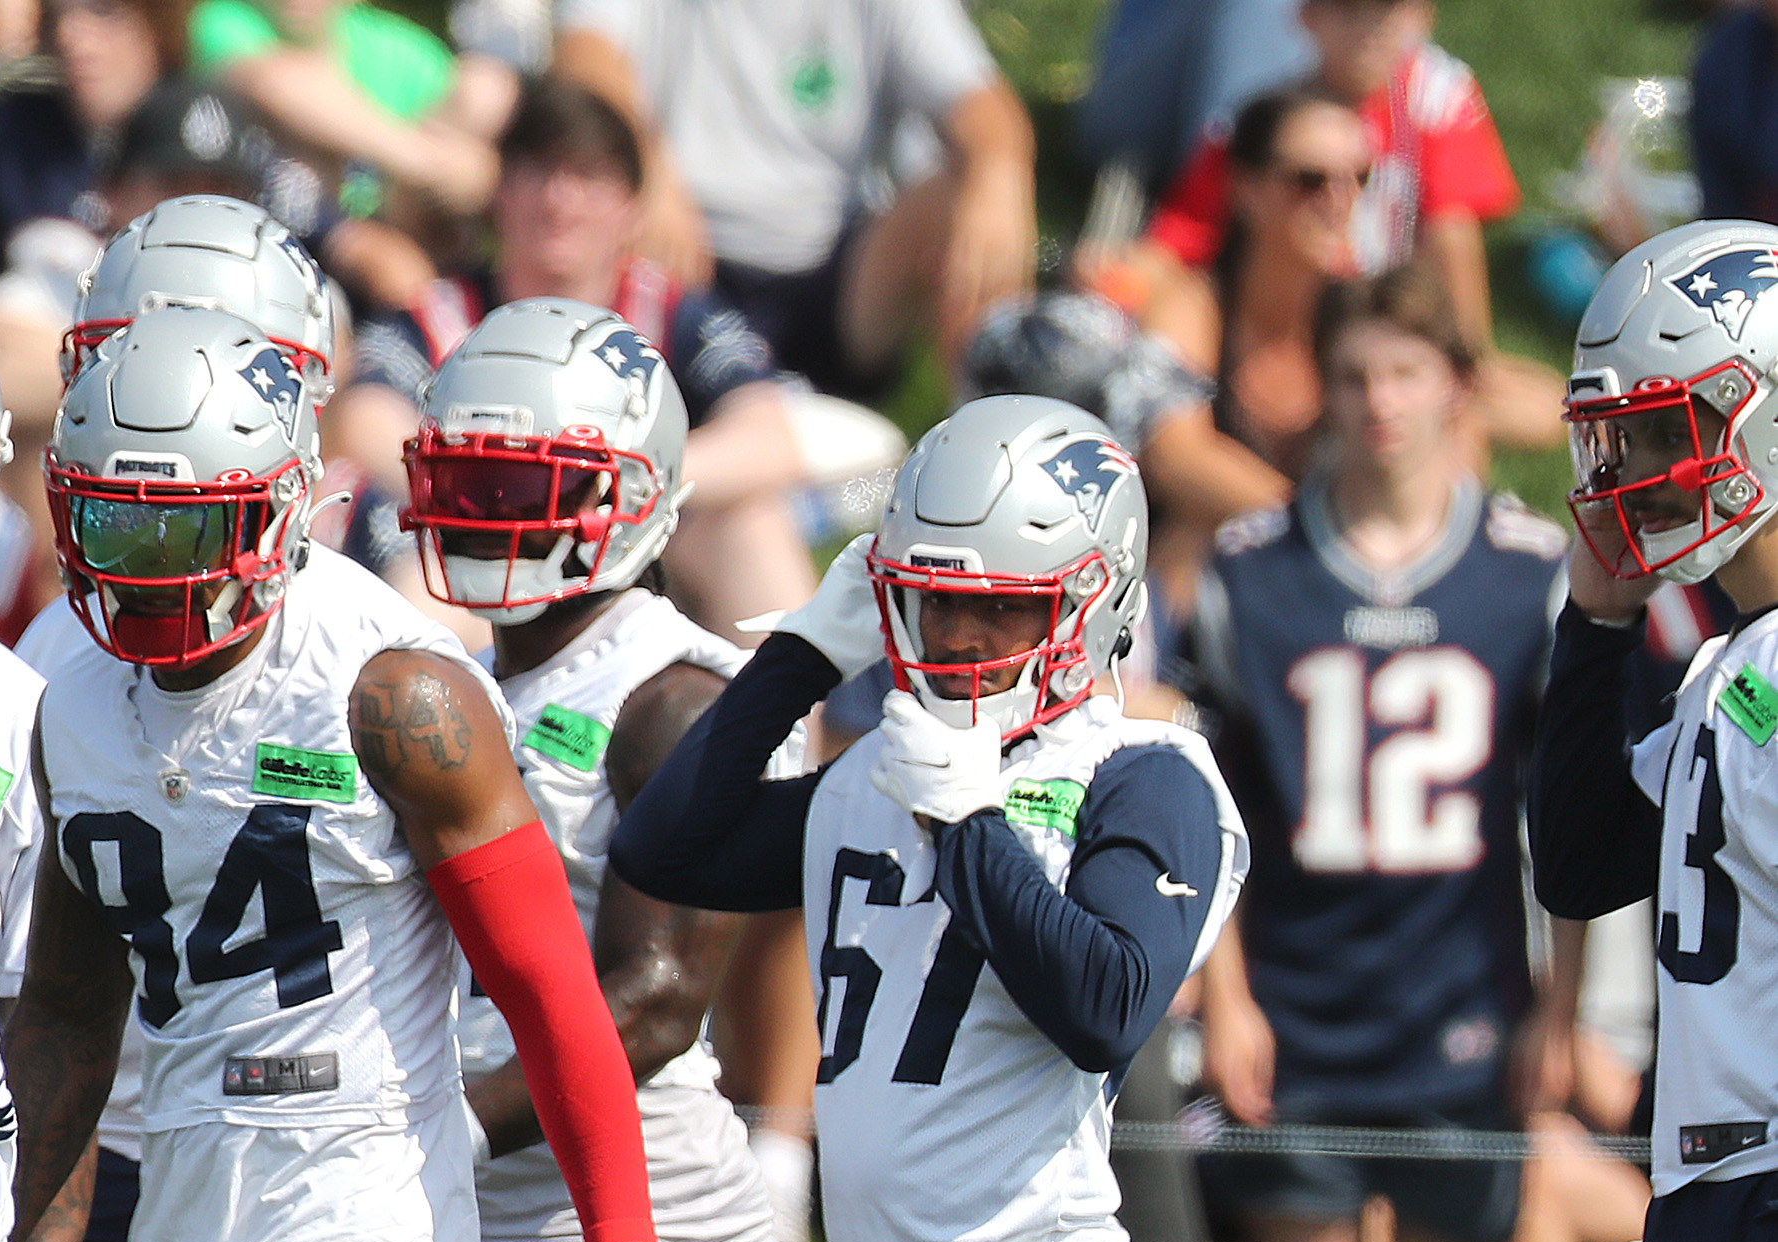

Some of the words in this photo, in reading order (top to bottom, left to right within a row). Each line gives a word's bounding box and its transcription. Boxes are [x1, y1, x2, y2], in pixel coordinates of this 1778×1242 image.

[1286, 645, 1496, 875] 12
[62, 804, 343, 1029] 84
[816, 847, 990, 1086] 67
